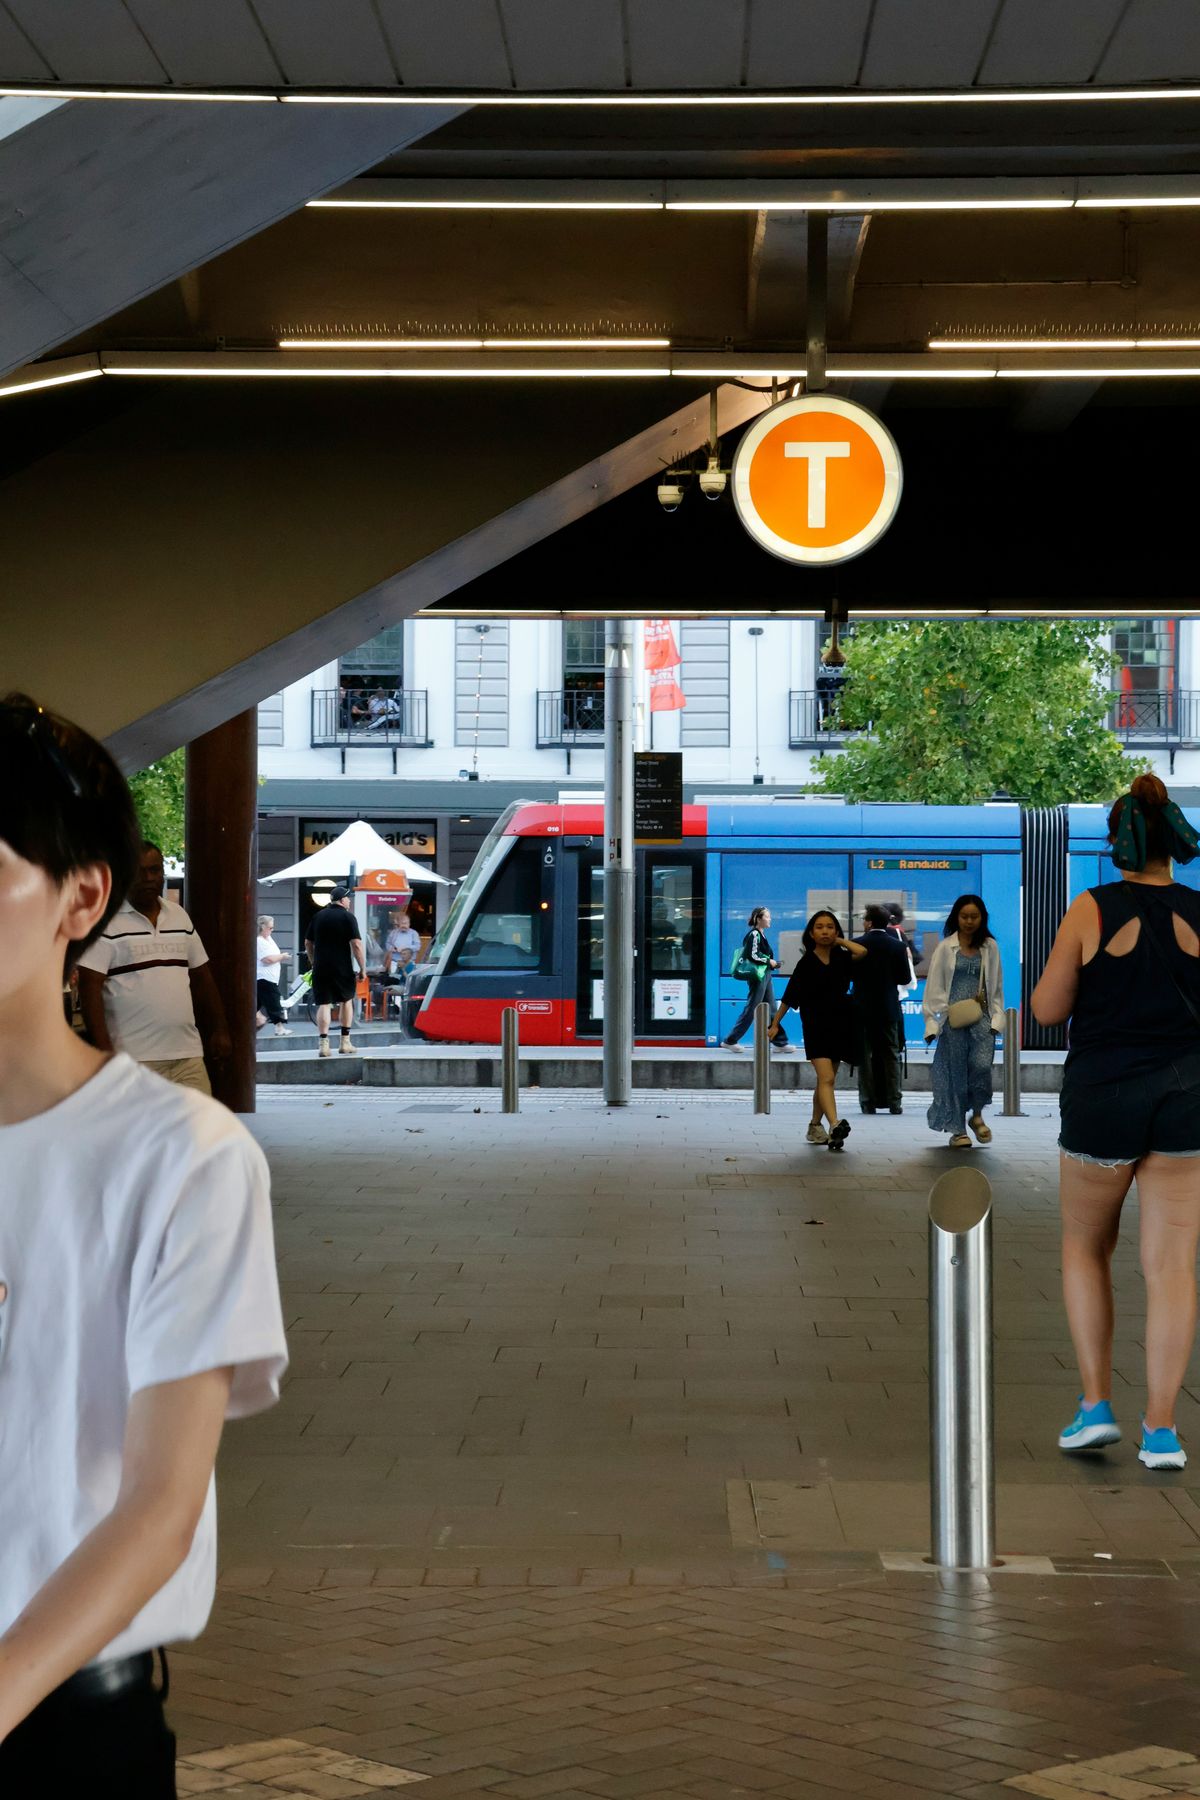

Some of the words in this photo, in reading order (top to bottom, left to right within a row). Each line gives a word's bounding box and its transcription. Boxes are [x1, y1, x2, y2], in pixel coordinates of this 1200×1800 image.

[784, 441, 850, 528] T
[311, 831, 428, 846] Mcald's
[870, 860, 885, 869] L2
[899, 860, 950, 869] Randwick
